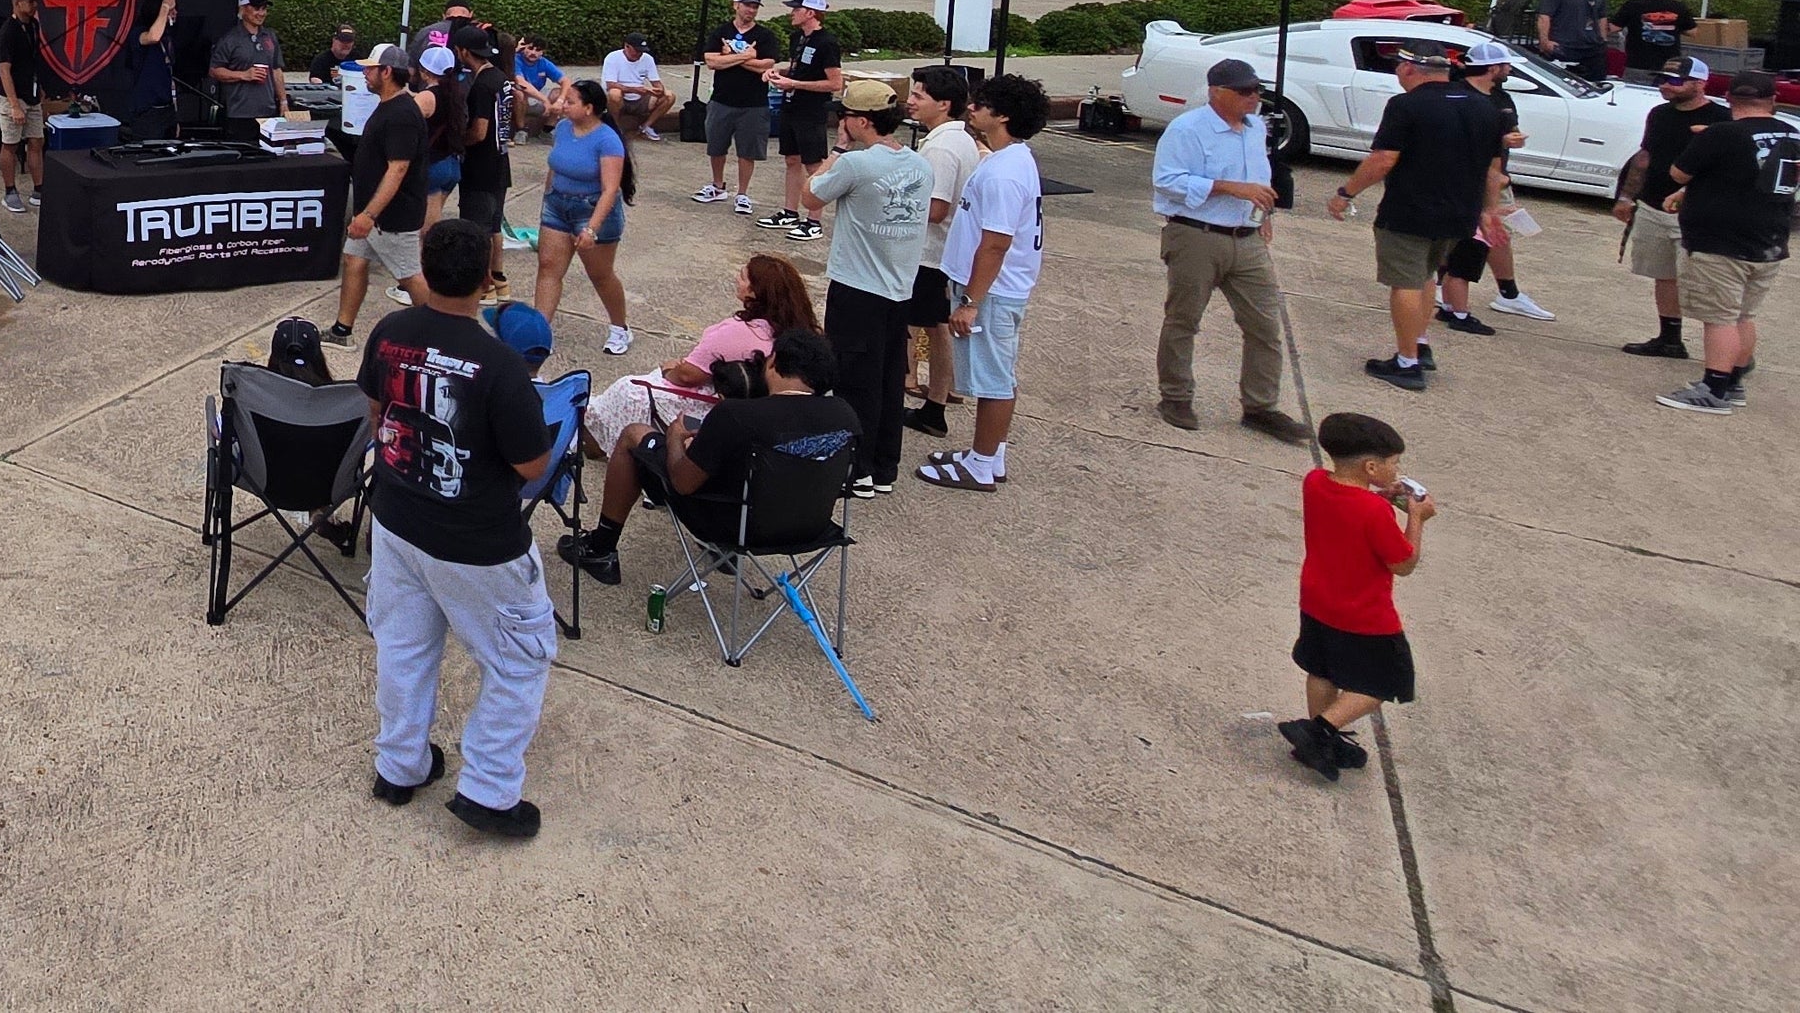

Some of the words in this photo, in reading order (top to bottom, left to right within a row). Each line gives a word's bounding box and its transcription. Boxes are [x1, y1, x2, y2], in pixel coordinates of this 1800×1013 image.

[117, 189, 325, 243] TRUFIBER
[131, 253, 196, 267] Aerodynamic
[198, 251, 231, 260] Parts
[250, 246, 309, 255] Accessories
[159, 244, 213, 256] Fiberglass
[226, 240, 259, 249] Carbon
[262, 238, 285, 246] Fiber
